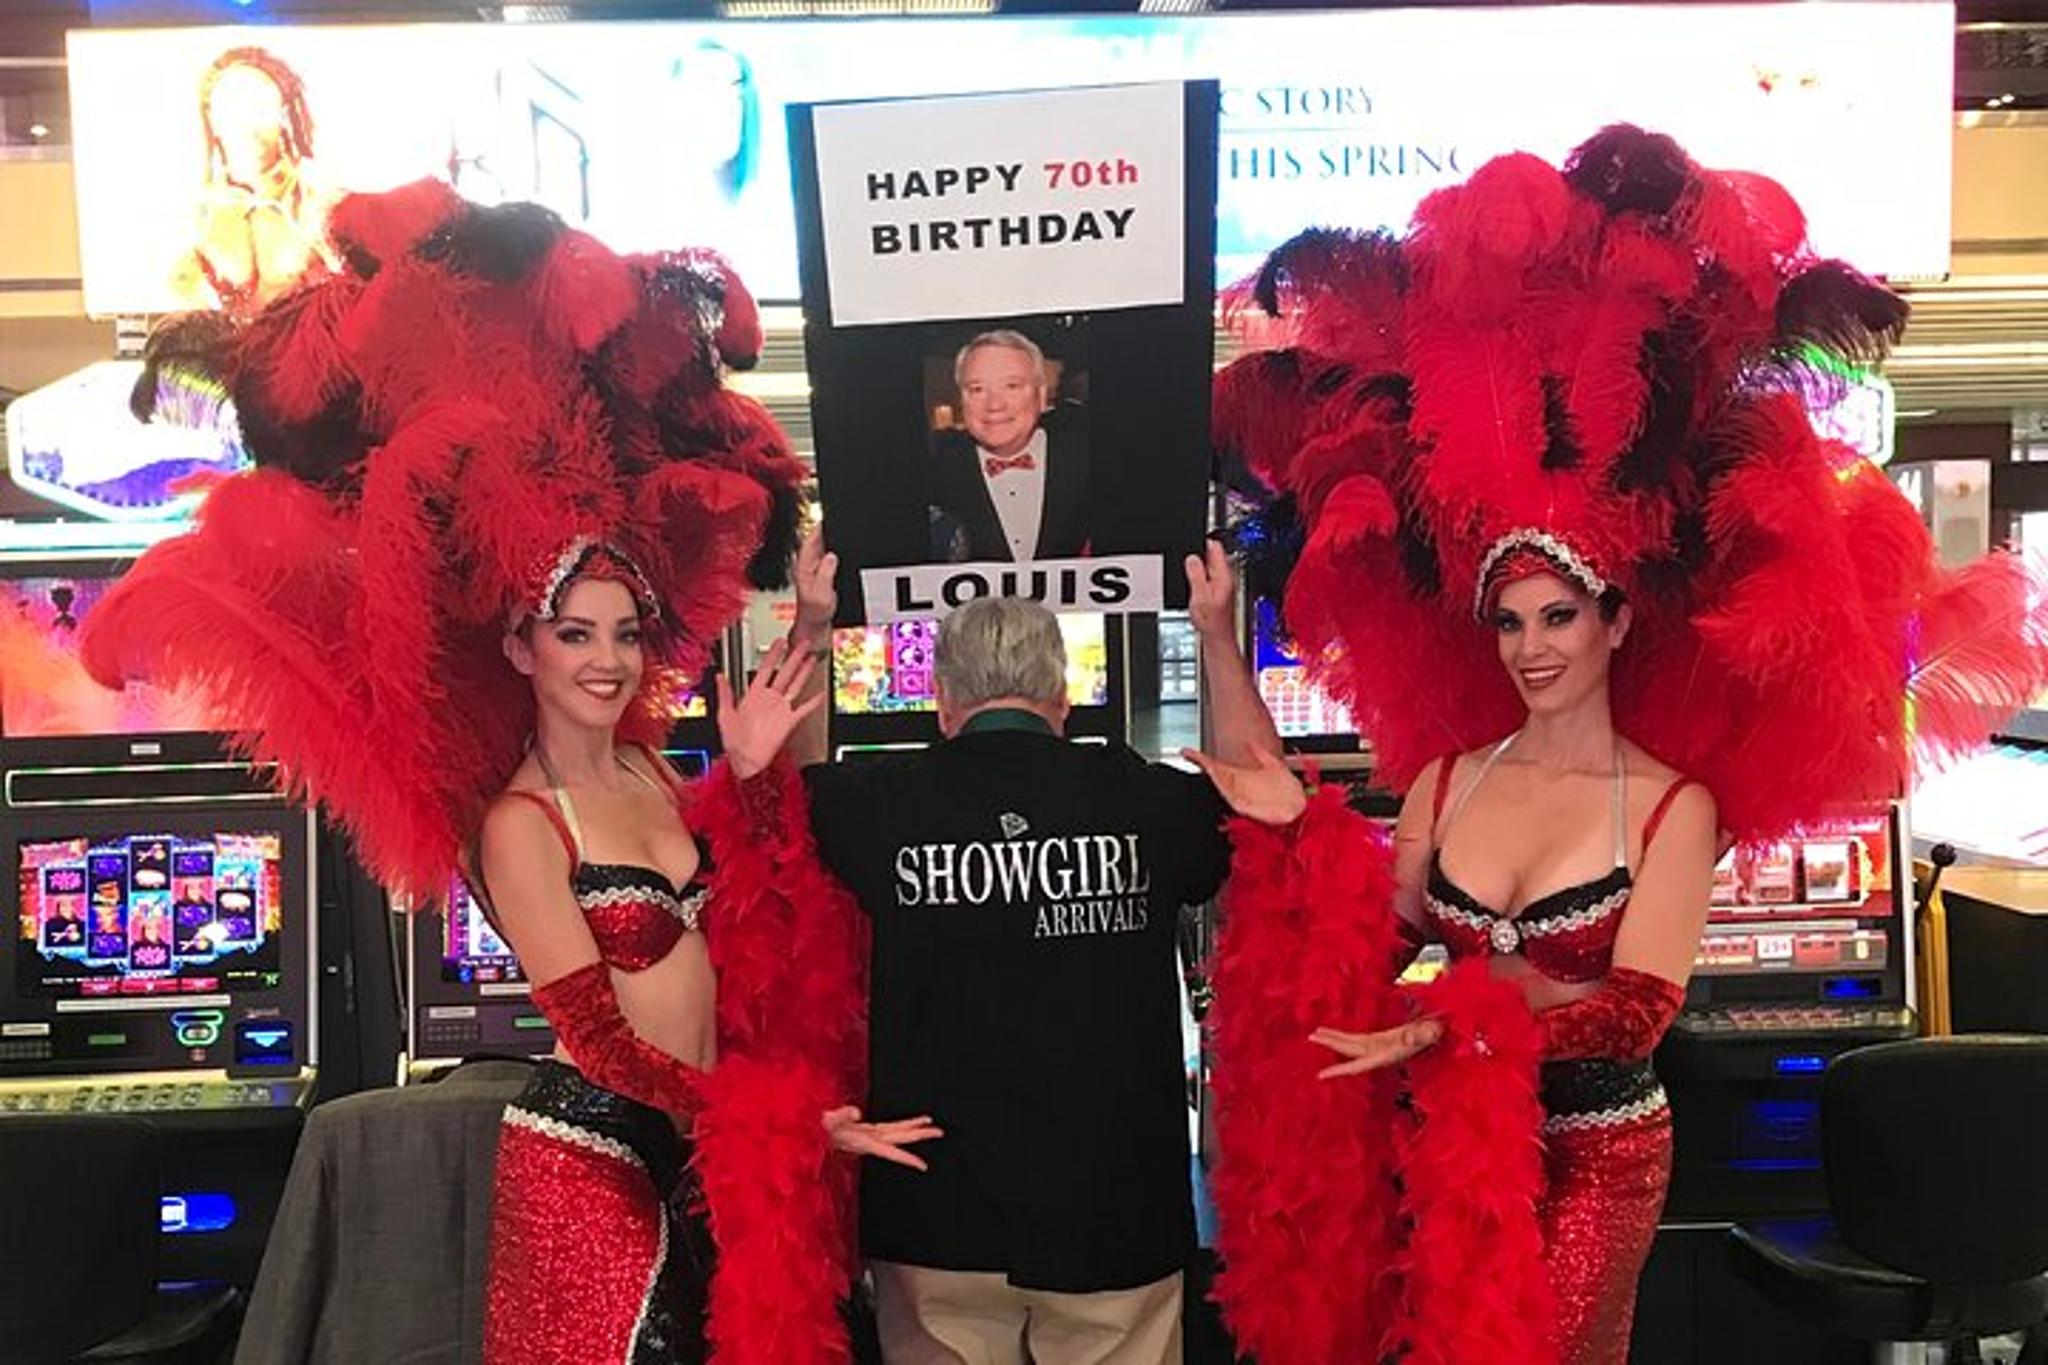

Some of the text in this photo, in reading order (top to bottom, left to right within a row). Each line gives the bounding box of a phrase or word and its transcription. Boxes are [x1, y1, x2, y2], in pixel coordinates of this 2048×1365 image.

[1218, 86, 1374, 117] C STORY
[867, 158, 1139, 201] HAPPY 70th
[1229, 146, 1302, 179] HIS
[871, 207, 1136, 255] BIRTHDAY
[894, 566, 1132, 612] LOUIS
[895, 834, 1150, 906] SHOWGIRL
[1034, 897, 1149, 937] ARRIVALS
